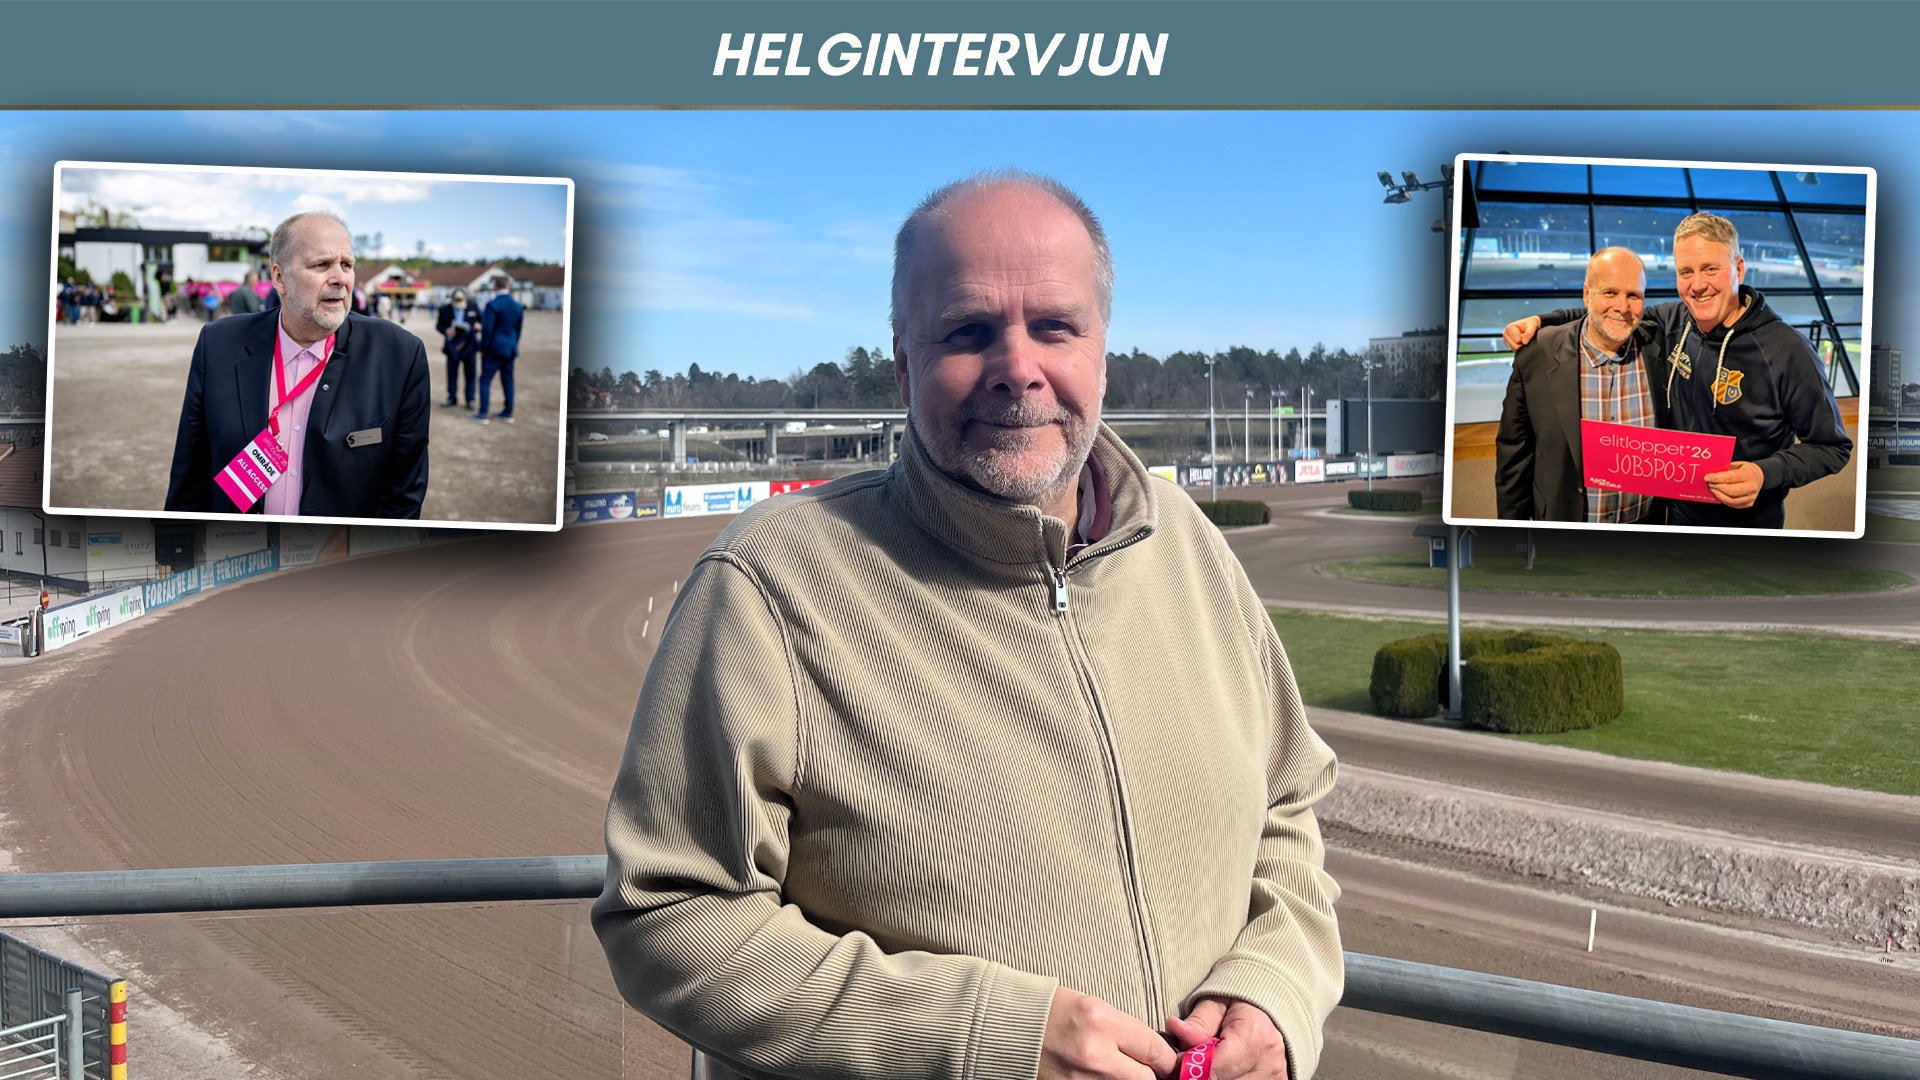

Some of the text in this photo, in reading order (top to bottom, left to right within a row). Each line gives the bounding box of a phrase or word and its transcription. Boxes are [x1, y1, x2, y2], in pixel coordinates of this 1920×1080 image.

[1599, 434, 1685, 456] elitloppet
[237, 458, 268, 493] ALL ACCESS
[252, 448, 276, 477] OMRÅDE
[1299, 465, 1320, 477] JULA
[1608, 453, 1701, 484] JOBSPOST
[667, 505, 682, 514] euro
[683, 502, 701, 512] finans
[216, 554, 246, 585] PERFECT
[248, 549, 273, 574] SPIRIT
[48, 615, 76, 641] offspring
[86, 605, 111, 628] offspring
